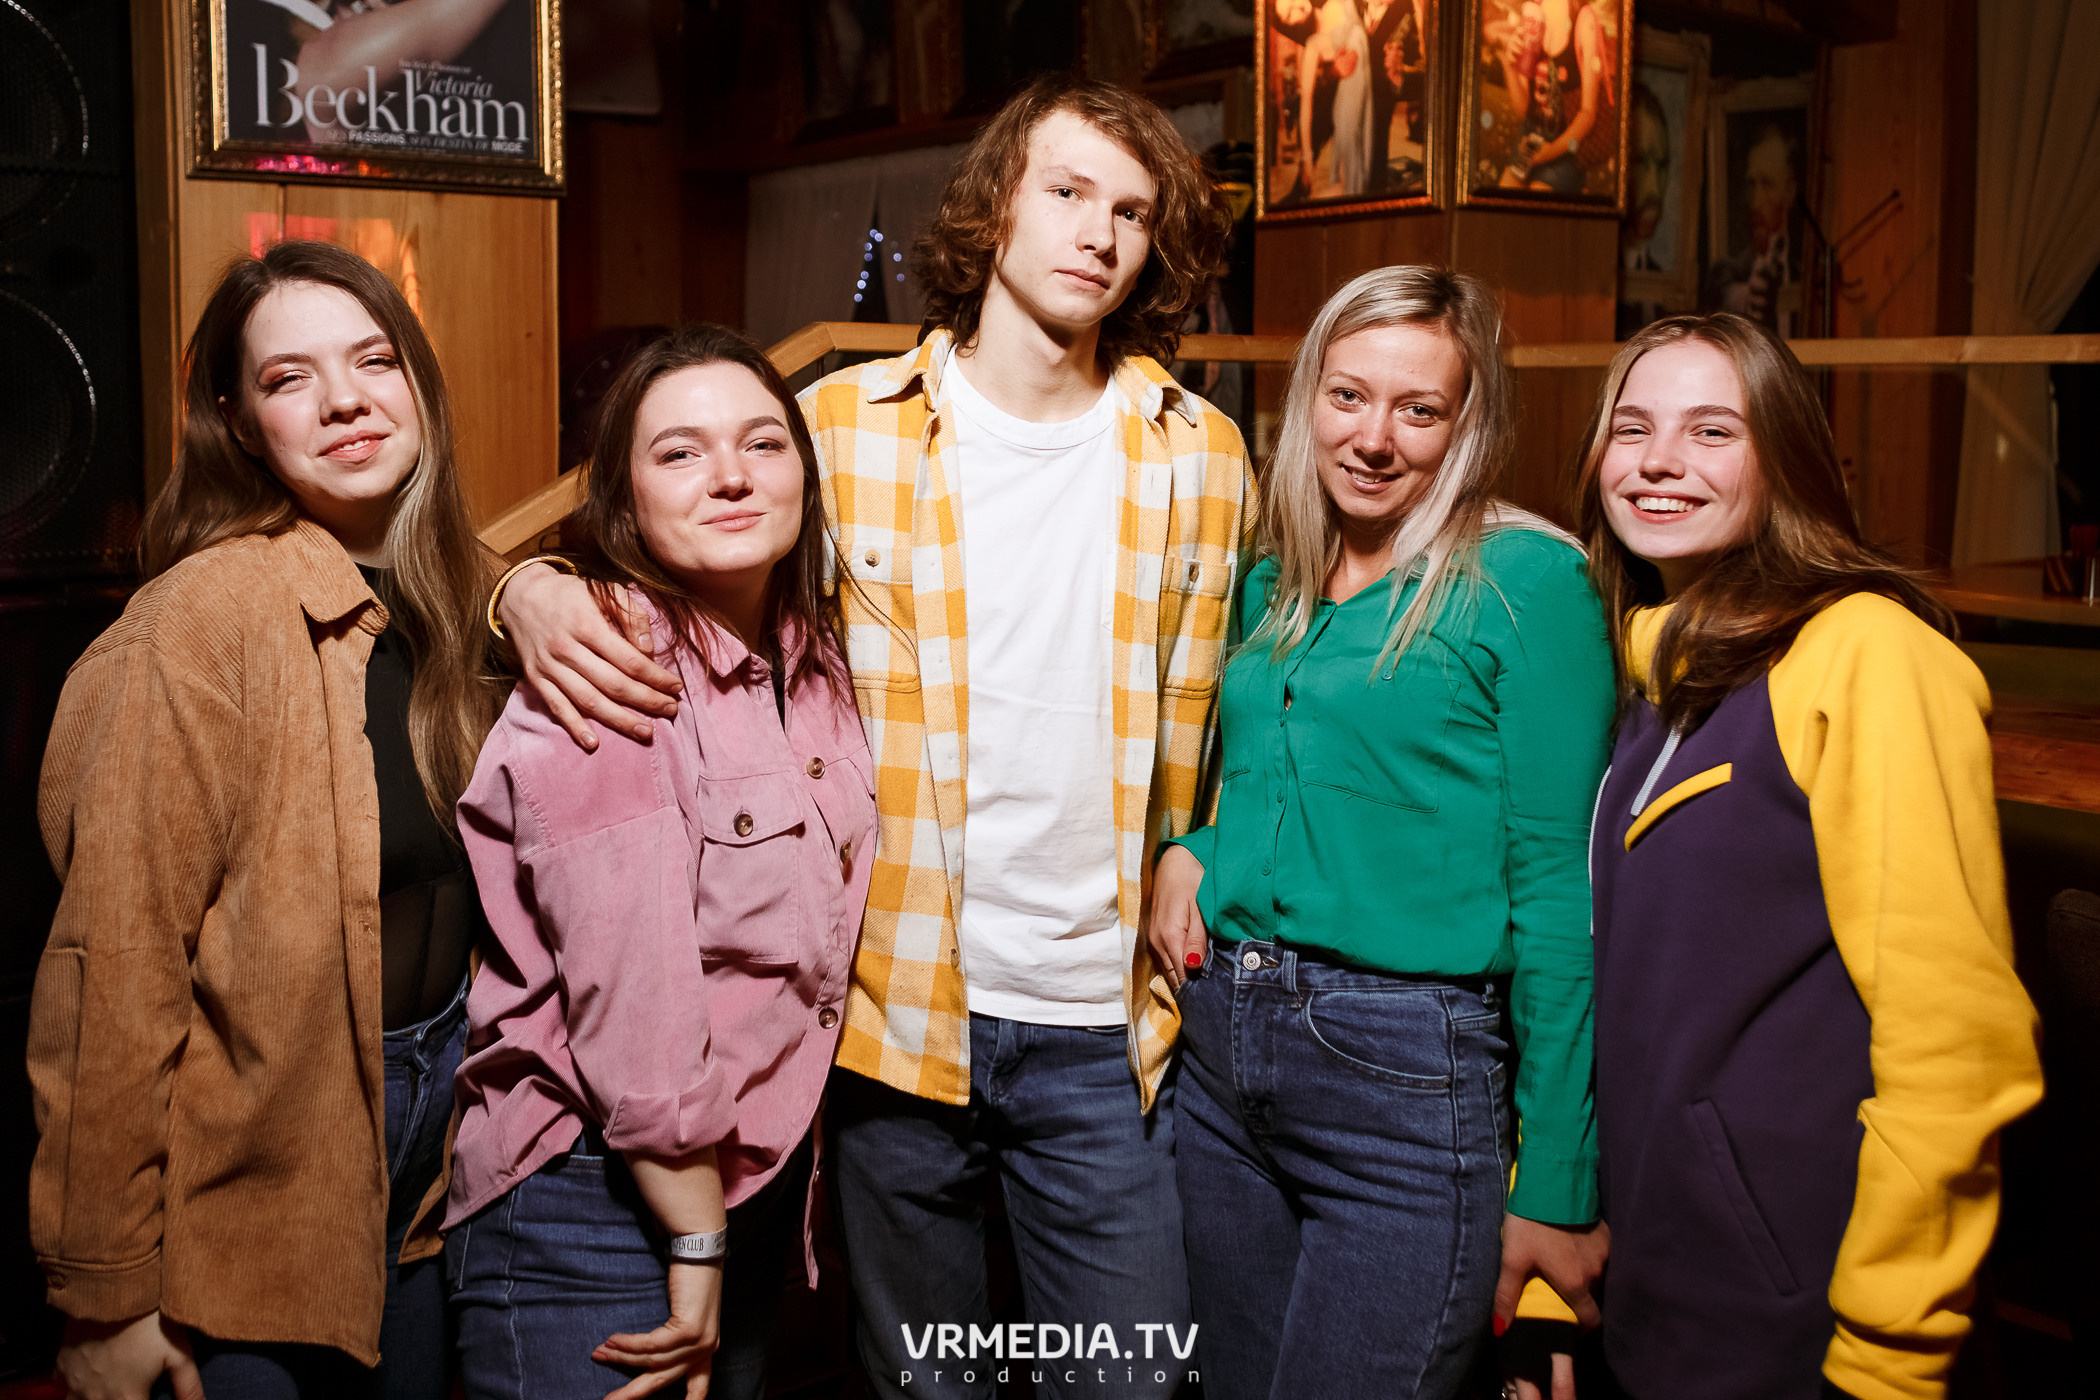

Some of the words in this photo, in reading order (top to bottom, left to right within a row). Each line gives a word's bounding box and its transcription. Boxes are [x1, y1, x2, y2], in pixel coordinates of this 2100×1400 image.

[251, 42, 529, 142] Beckham
[414, 69, 494, 99] Victoria
[687, 1237, 705, 1252] CLUB
